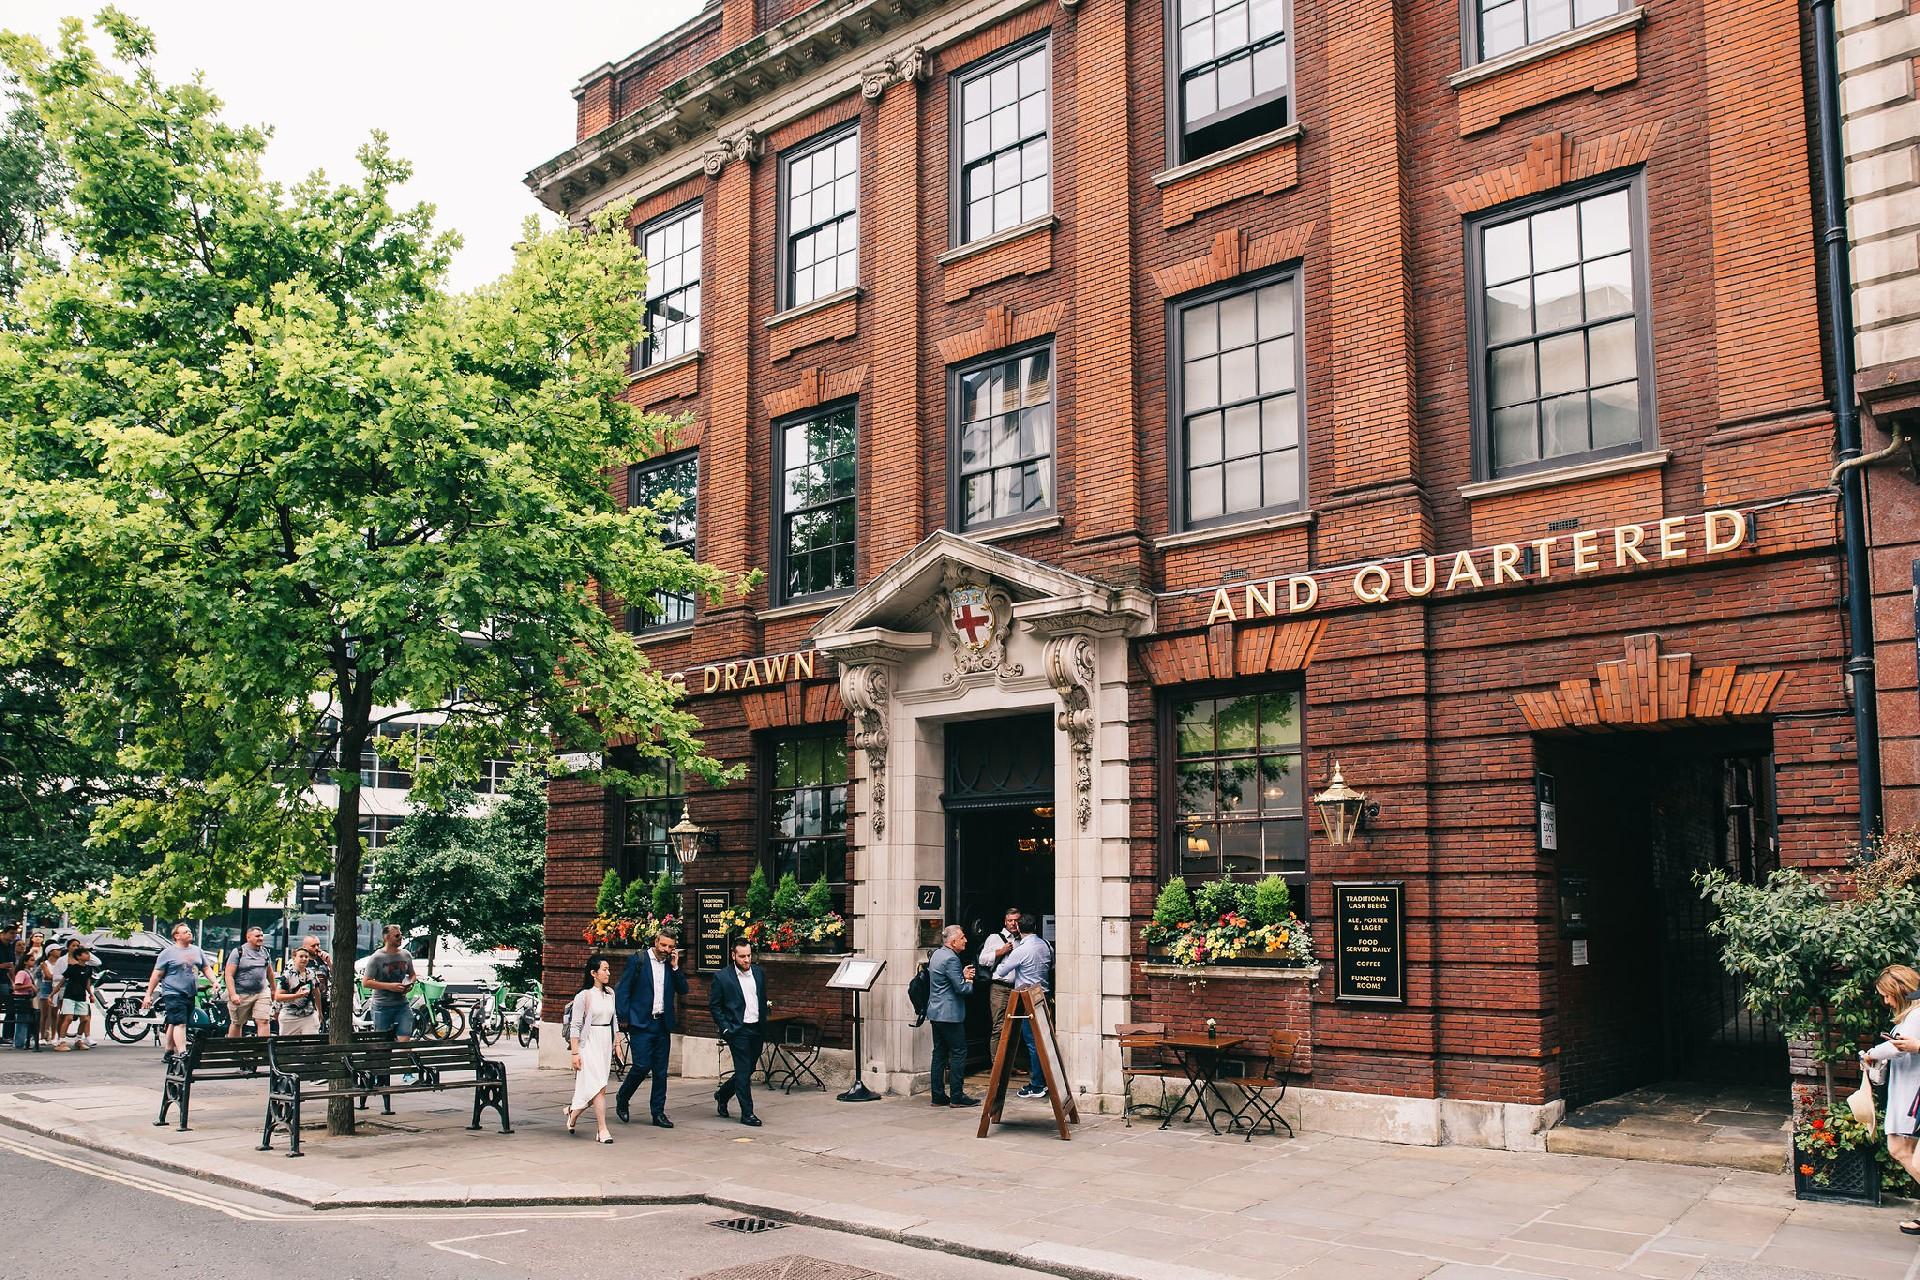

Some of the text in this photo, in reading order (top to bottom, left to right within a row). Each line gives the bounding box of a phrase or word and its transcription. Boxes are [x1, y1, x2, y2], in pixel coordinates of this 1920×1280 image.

[1207, 509, 1746, 625] AND QUARTERED
[704, 650, 814, 694] DRAWN
[923, 891, 935, 904] 27
